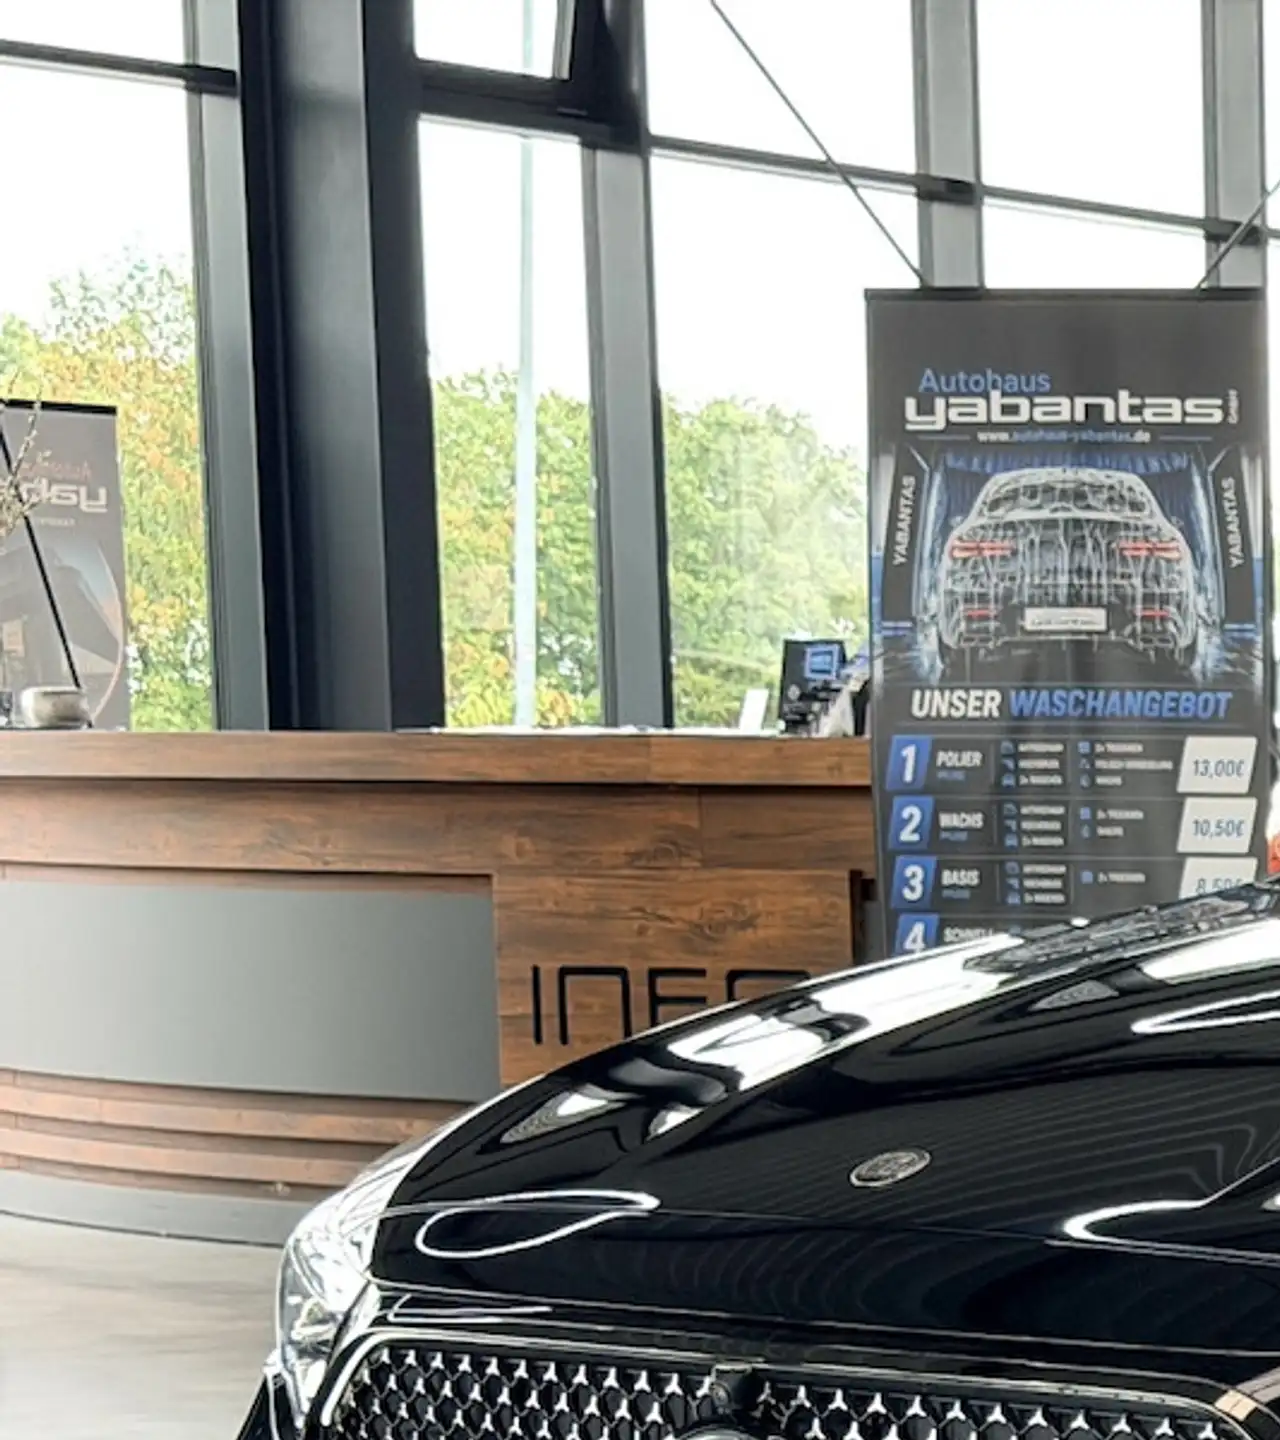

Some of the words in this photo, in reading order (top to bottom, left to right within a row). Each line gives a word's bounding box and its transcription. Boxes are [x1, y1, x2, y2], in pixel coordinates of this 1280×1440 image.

[918, 368, 1051, 393] Autohaus
[904, 389, 1224, 431] yabantas
[892, 475, 917, 566] YABANTAS
[1219, 477, 1245, 568] YABANTAS
[911, 689, 1000, 719] UNSER
[1009, 690, 1233, 720] WASCHANGEBOT
[901, 744, 917, 784] 1
[936, 751, 983, 768] POLIER
[1192, 759, 1246, 779] 13,00€
[899, 805, 923, 843] 2
[1191, 819, 1246, 839] 10,50€
[902, 864, 925, 903] 3
[941, 869, 981, 887] BASIS
[903, 921, 925, 953] 4
